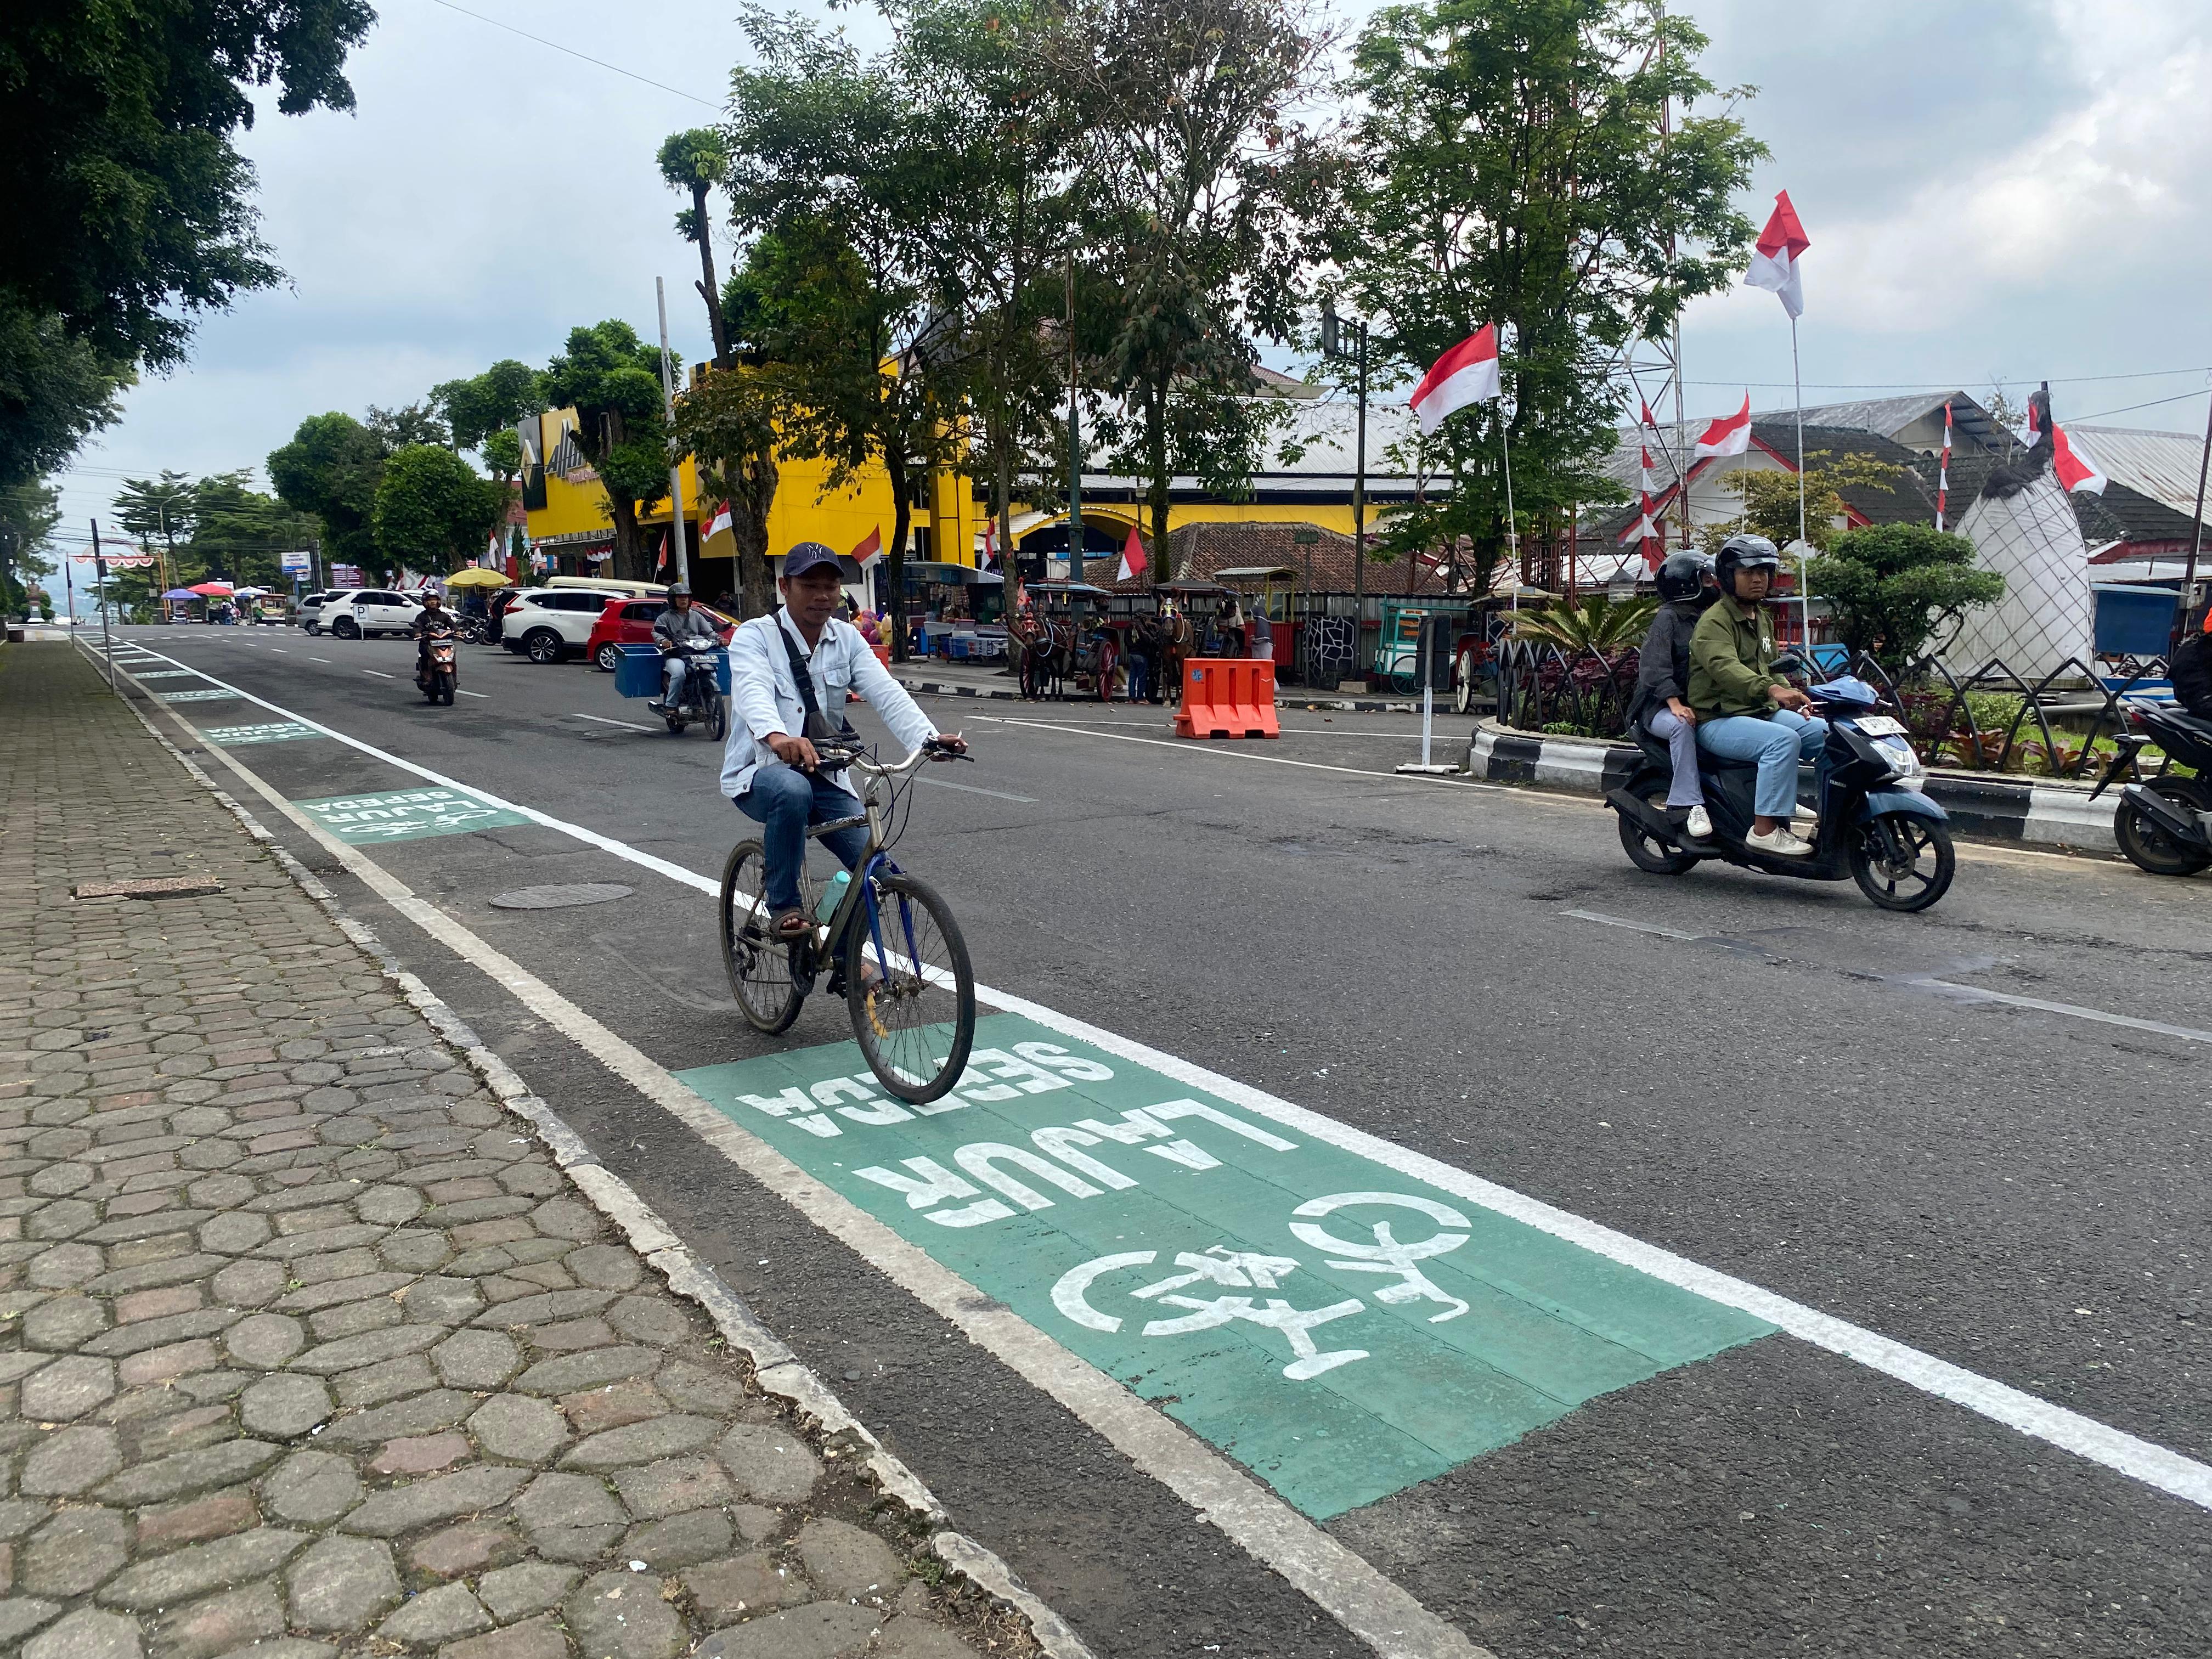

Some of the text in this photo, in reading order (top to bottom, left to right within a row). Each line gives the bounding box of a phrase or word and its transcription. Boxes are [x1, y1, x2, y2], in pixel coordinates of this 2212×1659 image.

[358, 607, 365, 617] P
[303, 791, 454, 812] SEPEDA
[319, 800, 481, 823] LAJUR
[851, 1098, 1300, 1228] LAJUR
